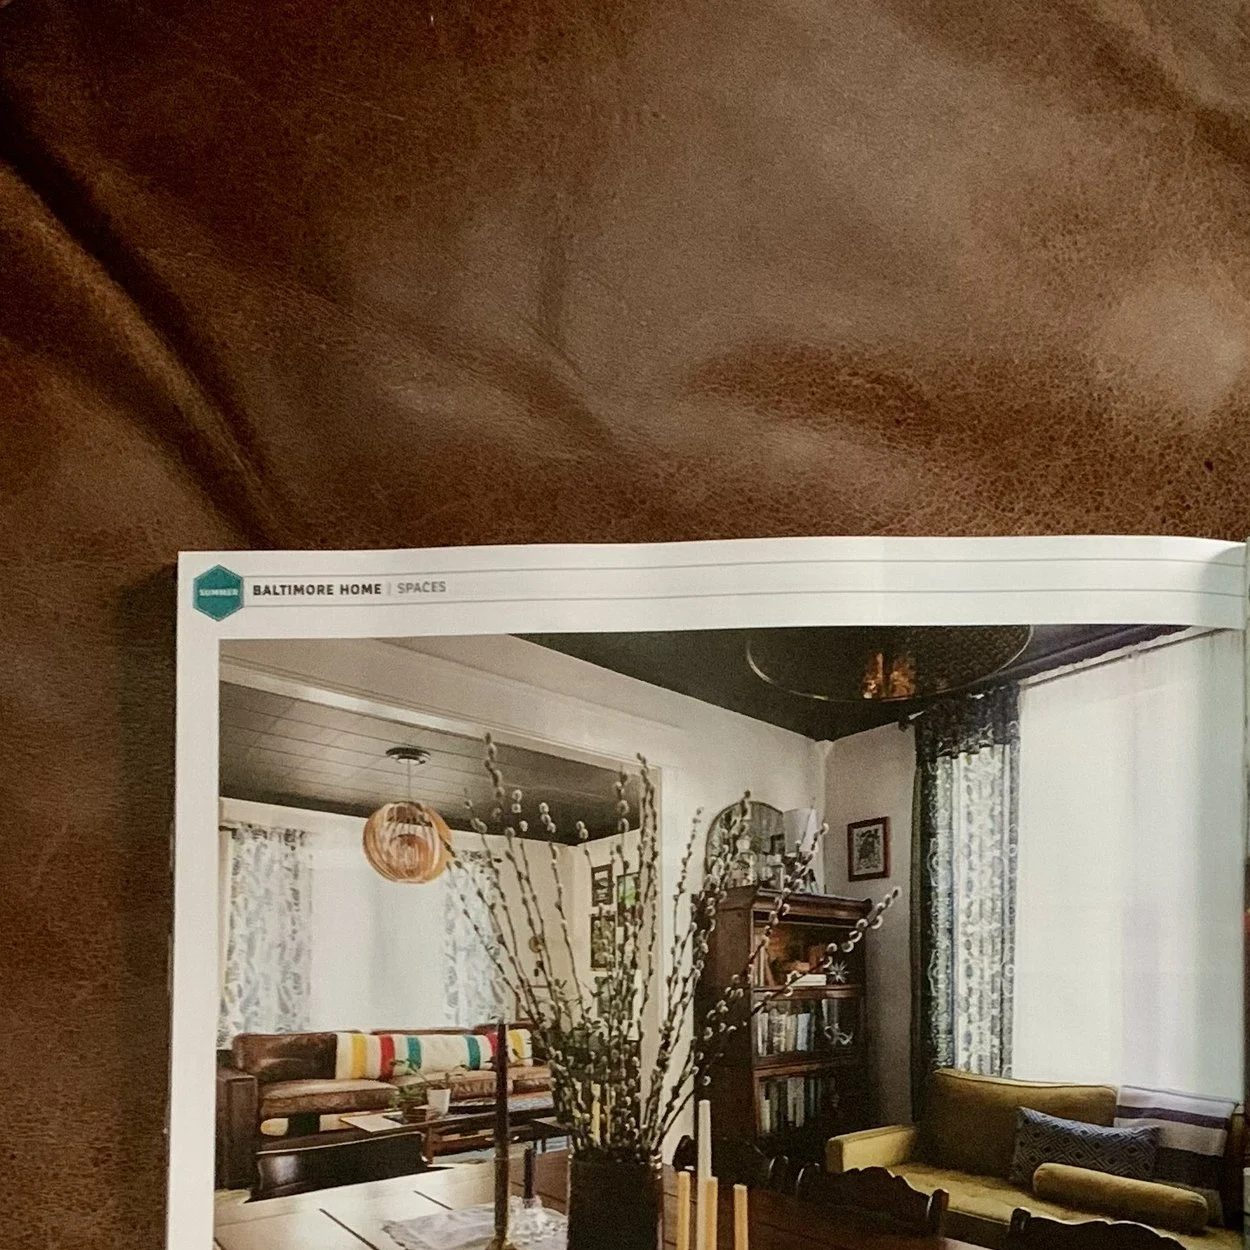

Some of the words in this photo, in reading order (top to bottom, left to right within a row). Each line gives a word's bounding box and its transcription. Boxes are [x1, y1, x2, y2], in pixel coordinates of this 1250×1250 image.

[199, 588, 239, 597] SUMMER
[252, 584, 334, 595] BALTIMORE
[339, 583, 381, 595] HOME
[396, 580, 446, 593] SPACES
